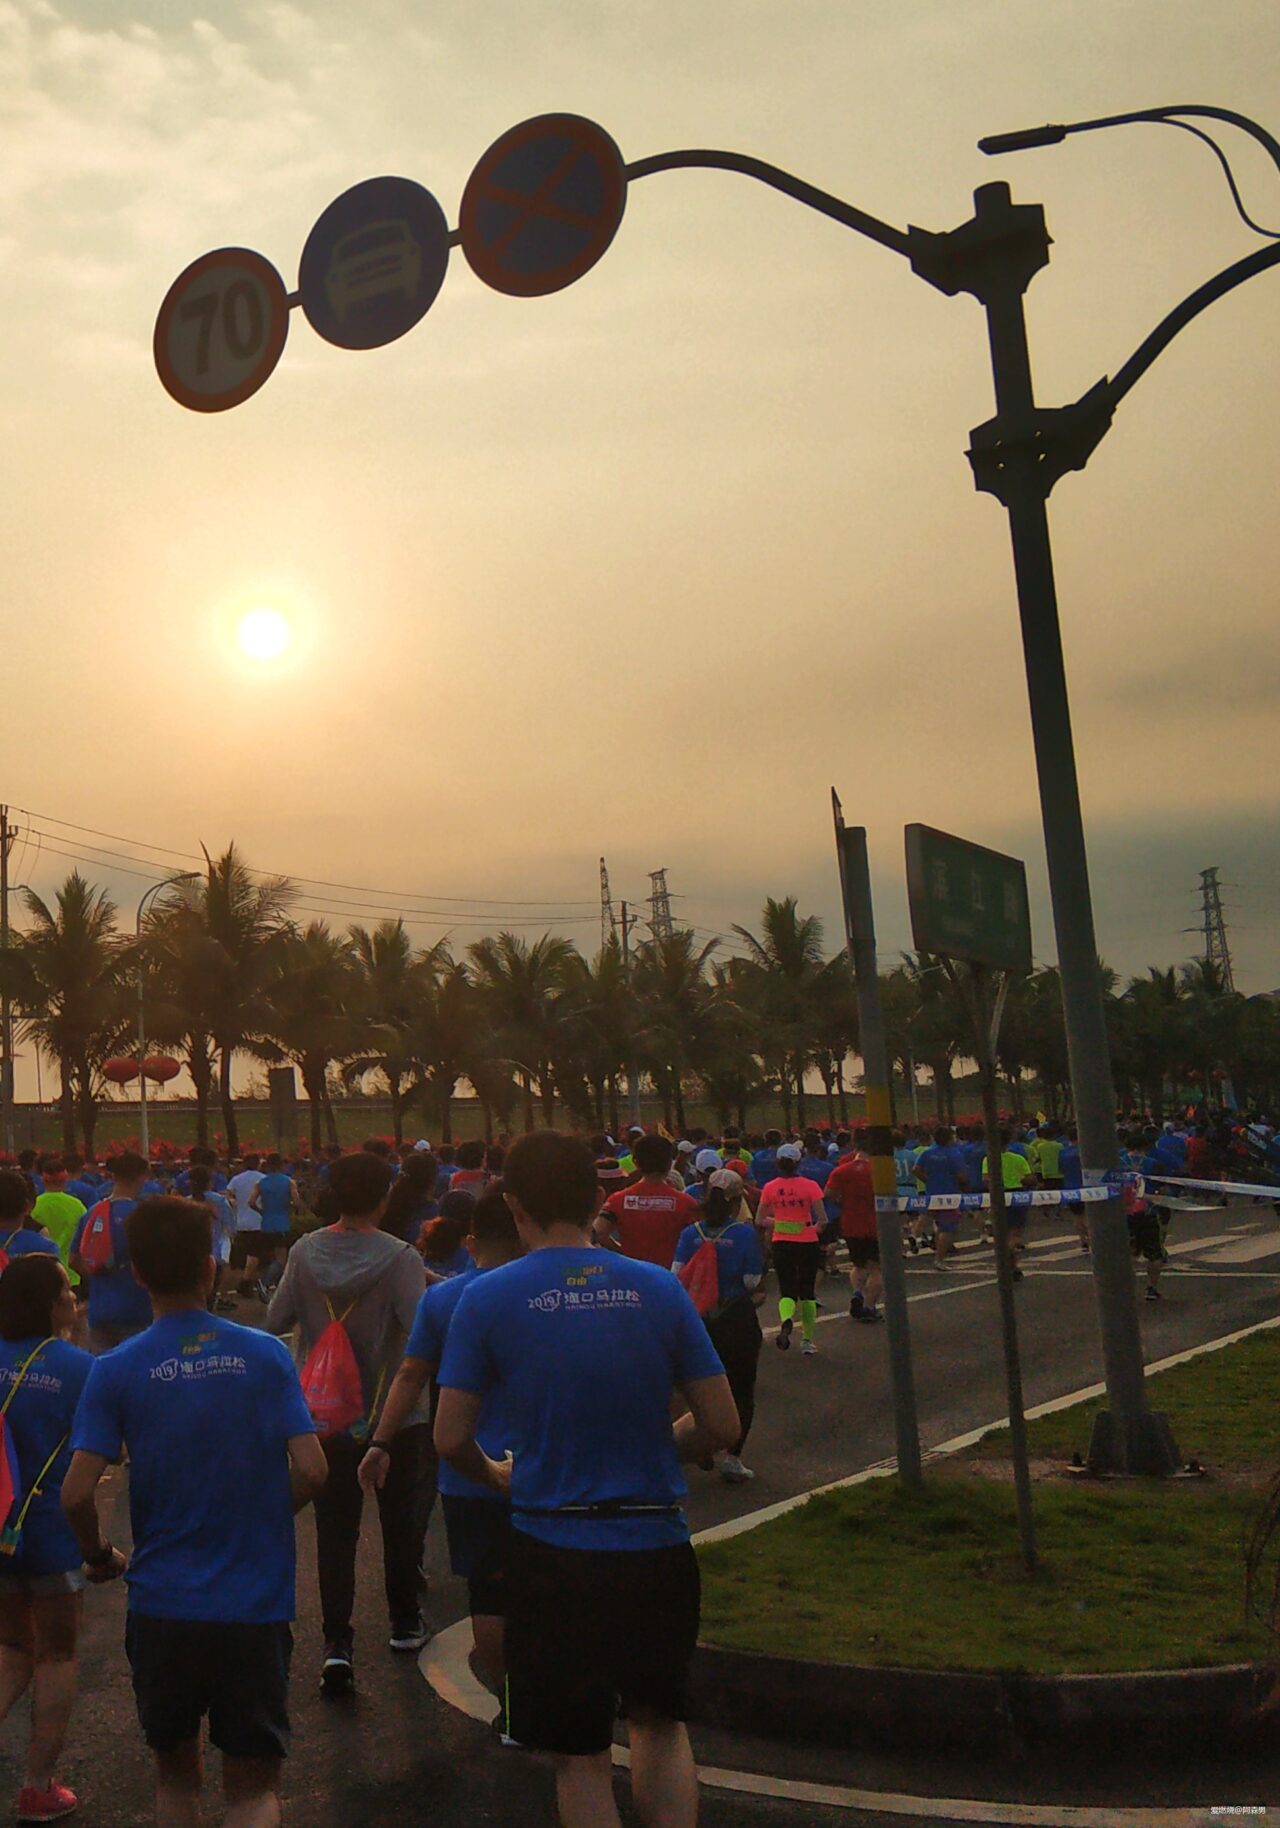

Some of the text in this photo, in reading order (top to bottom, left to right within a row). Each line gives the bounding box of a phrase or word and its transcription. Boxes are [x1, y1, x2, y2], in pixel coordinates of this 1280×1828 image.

[179, 281, 263, 376] 70
[527, 1289, 640, 1309] 2019 海口马拉松
[149, 1356, 246, 1380] 2019 海口马拉松
